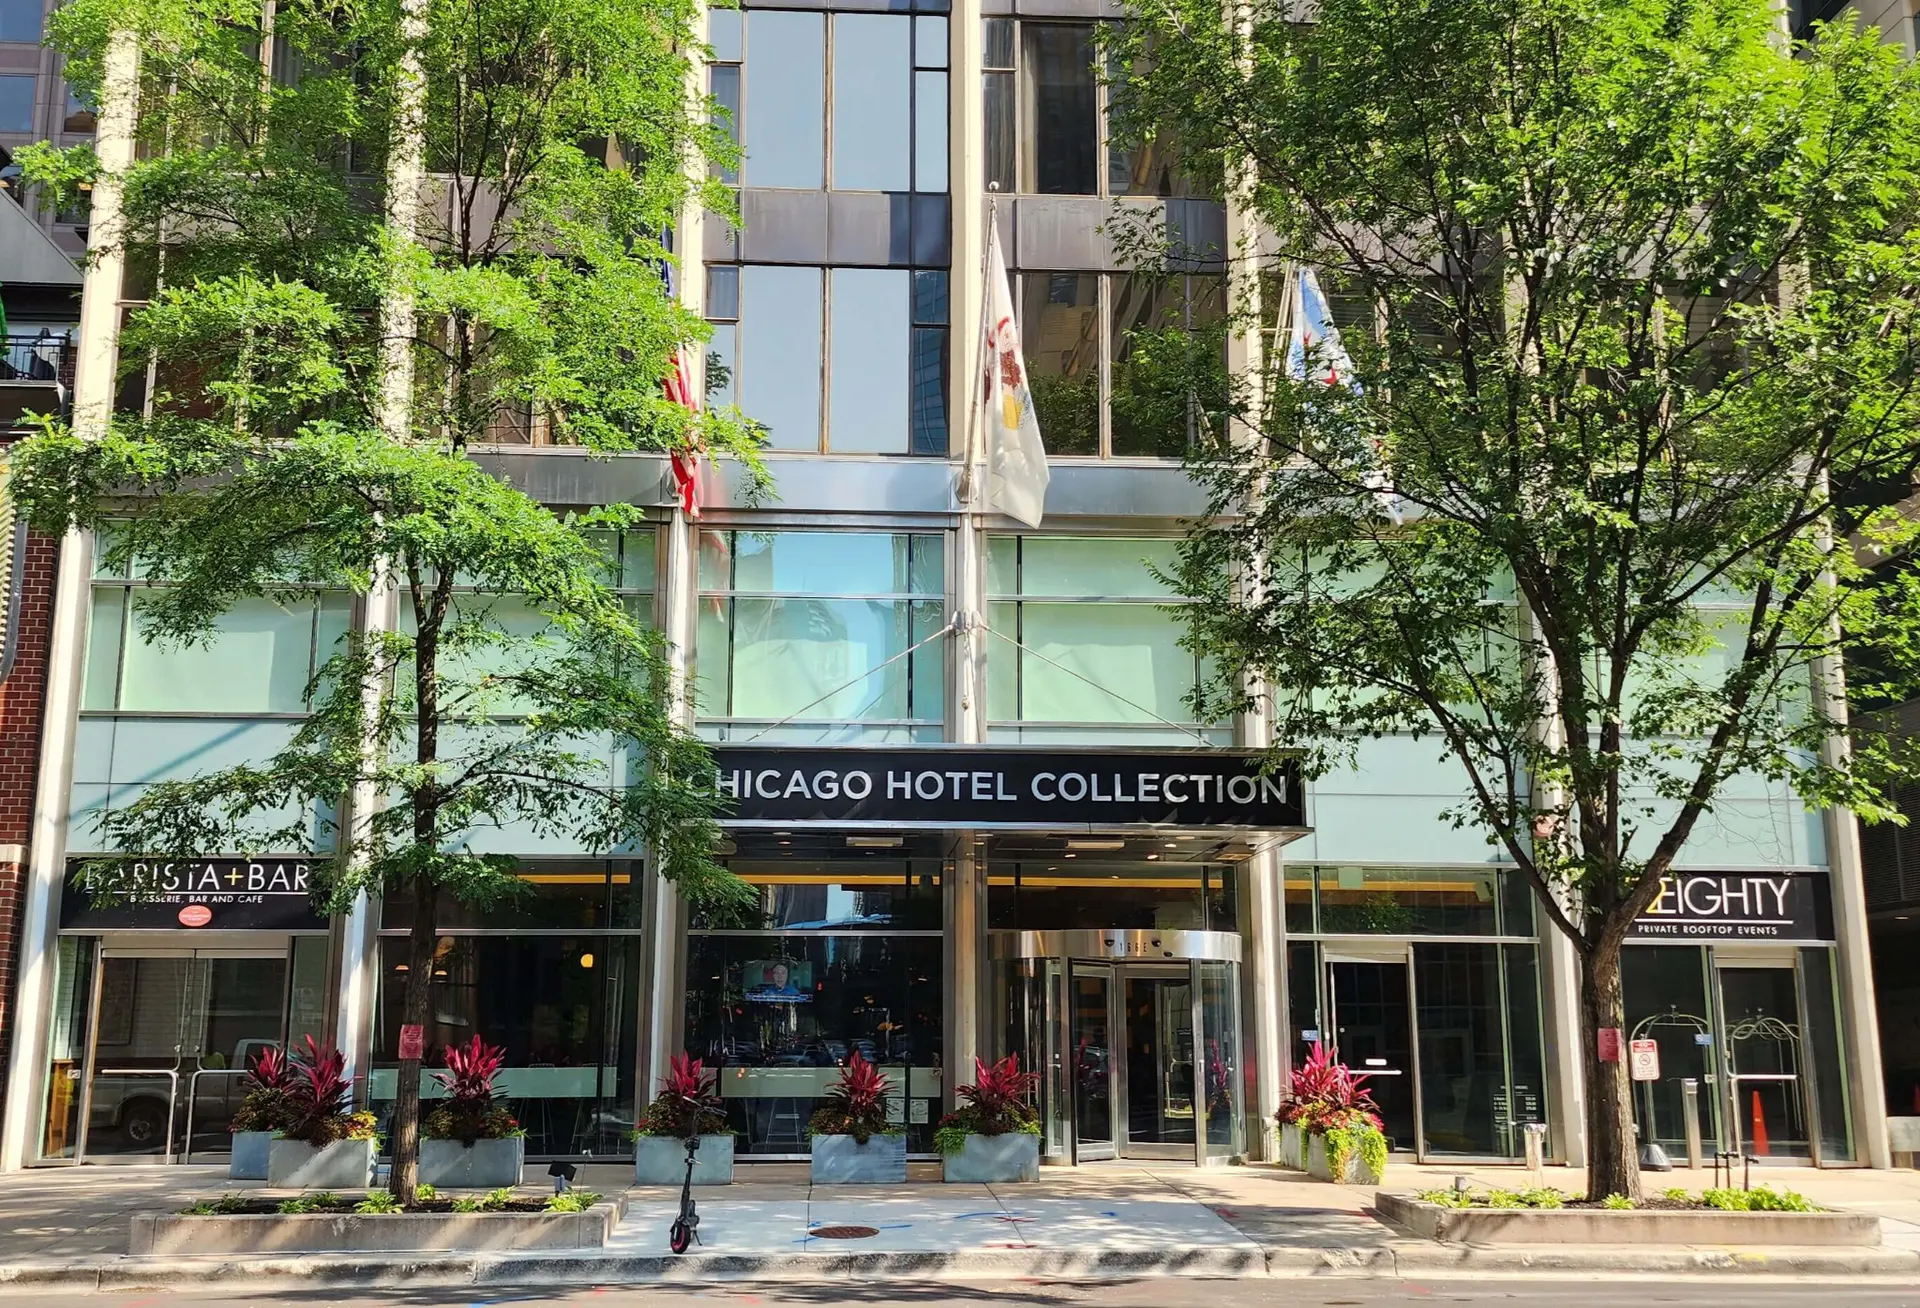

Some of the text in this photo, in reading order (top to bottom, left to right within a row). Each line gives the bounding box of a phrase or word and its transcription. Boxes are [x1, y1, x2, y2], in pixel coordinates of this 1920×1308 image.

[886, 770, 1018, 801] HOTEL
[1030, 772, 1288, 804] COLLECTION
[129, 894, 264, 904] BASSERIE, BAR AND CAFE
[1637, 924, 1778, 936] PRIVATE ROOFTOP EVENTS
